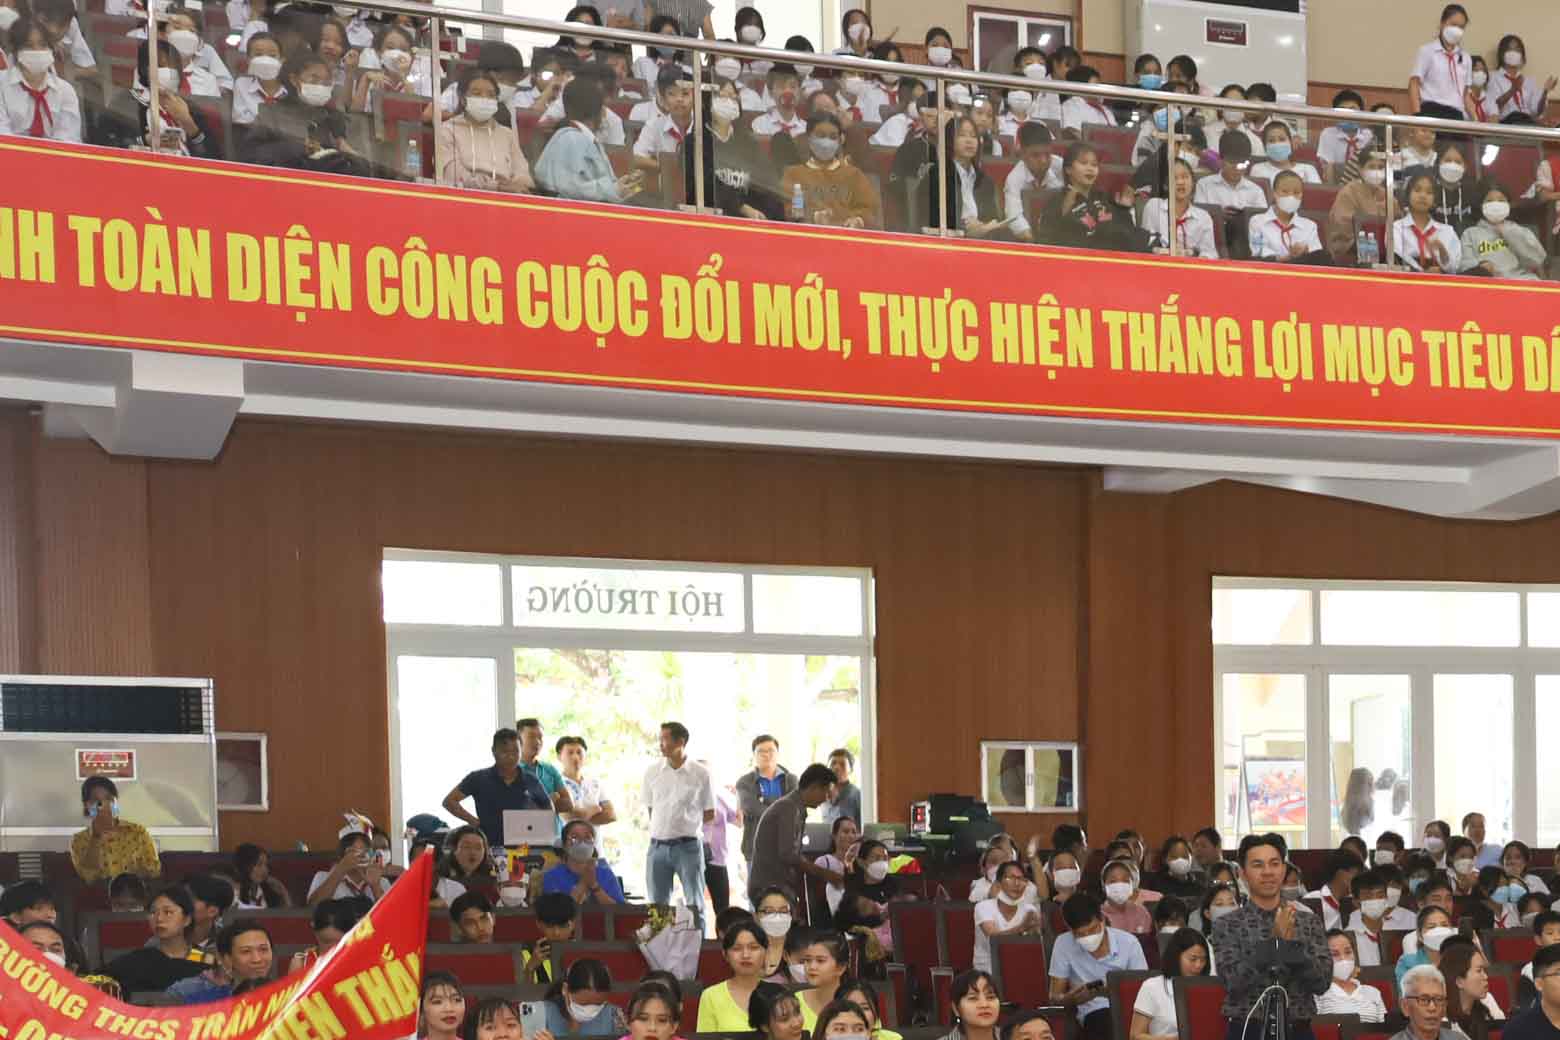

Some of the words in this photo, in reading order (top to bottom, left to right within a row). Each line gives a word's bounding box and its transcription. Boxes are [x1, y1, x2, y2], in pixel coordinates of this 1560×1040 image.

[68, 207, 212, 298] TOÀN
[227, 225, 353, 322] DIỆN
[366, 237, 504, 326] CÔNG
[517, 255, 649, 347] CUỘC
[661, 253, 743, 346] ĐỔI
[753, 272, 852, 360] MỚI,
[860, 288, 979, 372] THỰC
[990, 294, 1093, 380] HIỆN
[1102, 294, 1244, 377] THẮNG
[1252, 312, 1314, 392] LỢI
[1322, 325, 1415, 396] MỤC
[1422, 322, 1513, 392] TIÊU
